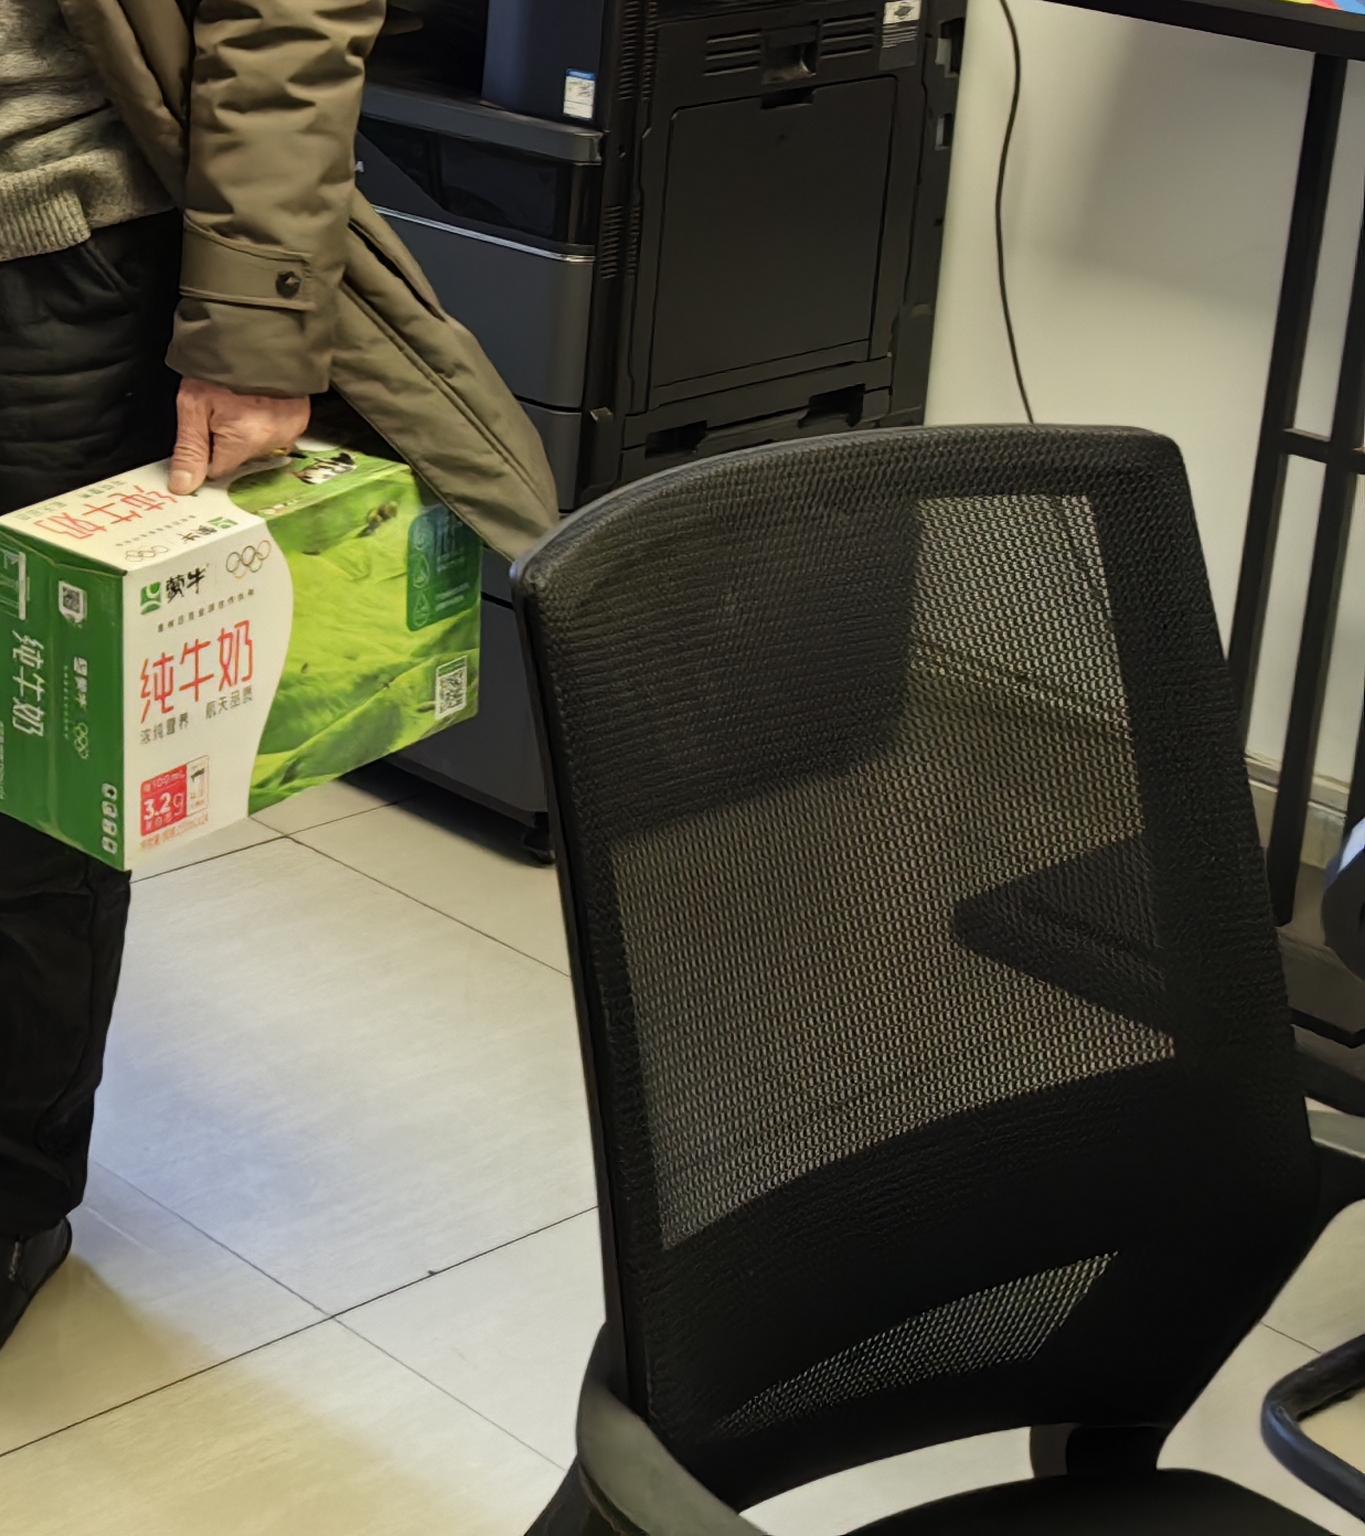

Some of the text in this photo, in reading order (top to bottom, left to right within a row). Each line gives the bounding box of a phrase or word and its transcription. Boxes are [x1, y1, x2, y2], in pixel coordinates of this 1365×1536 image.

[166, 568, 205, 602] 蒙牛
[141, 620, 253, 722] 纯牛奶
[142, 789, 186, 822] 3.2g
